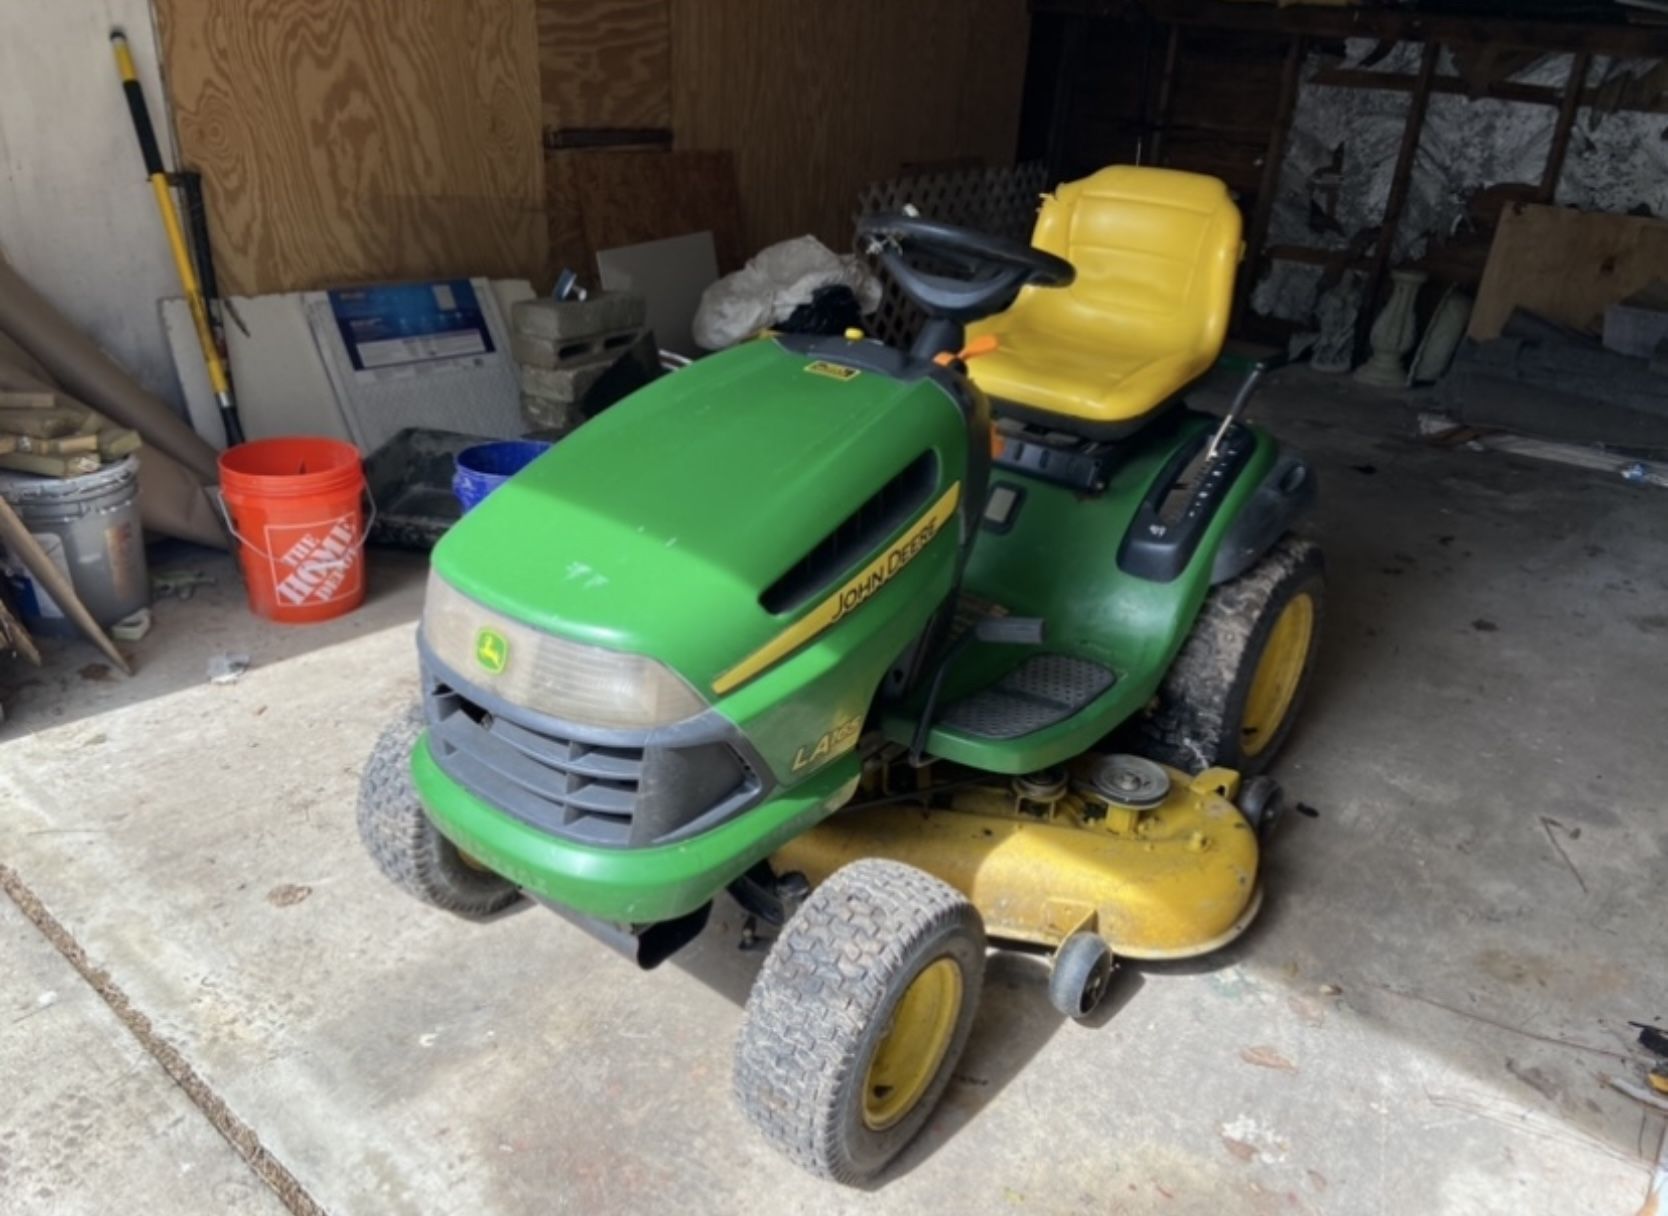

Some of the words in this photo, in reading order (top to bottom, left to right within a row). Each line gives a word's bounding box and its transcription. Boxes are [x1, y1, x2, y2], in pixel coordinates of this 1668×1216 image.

[276, 516, 356, 605] HOME
[280, 533, 321, 567] THE
[831, 565, 885, 620] JOHN
[887, 515, 938, 573] DEERE
